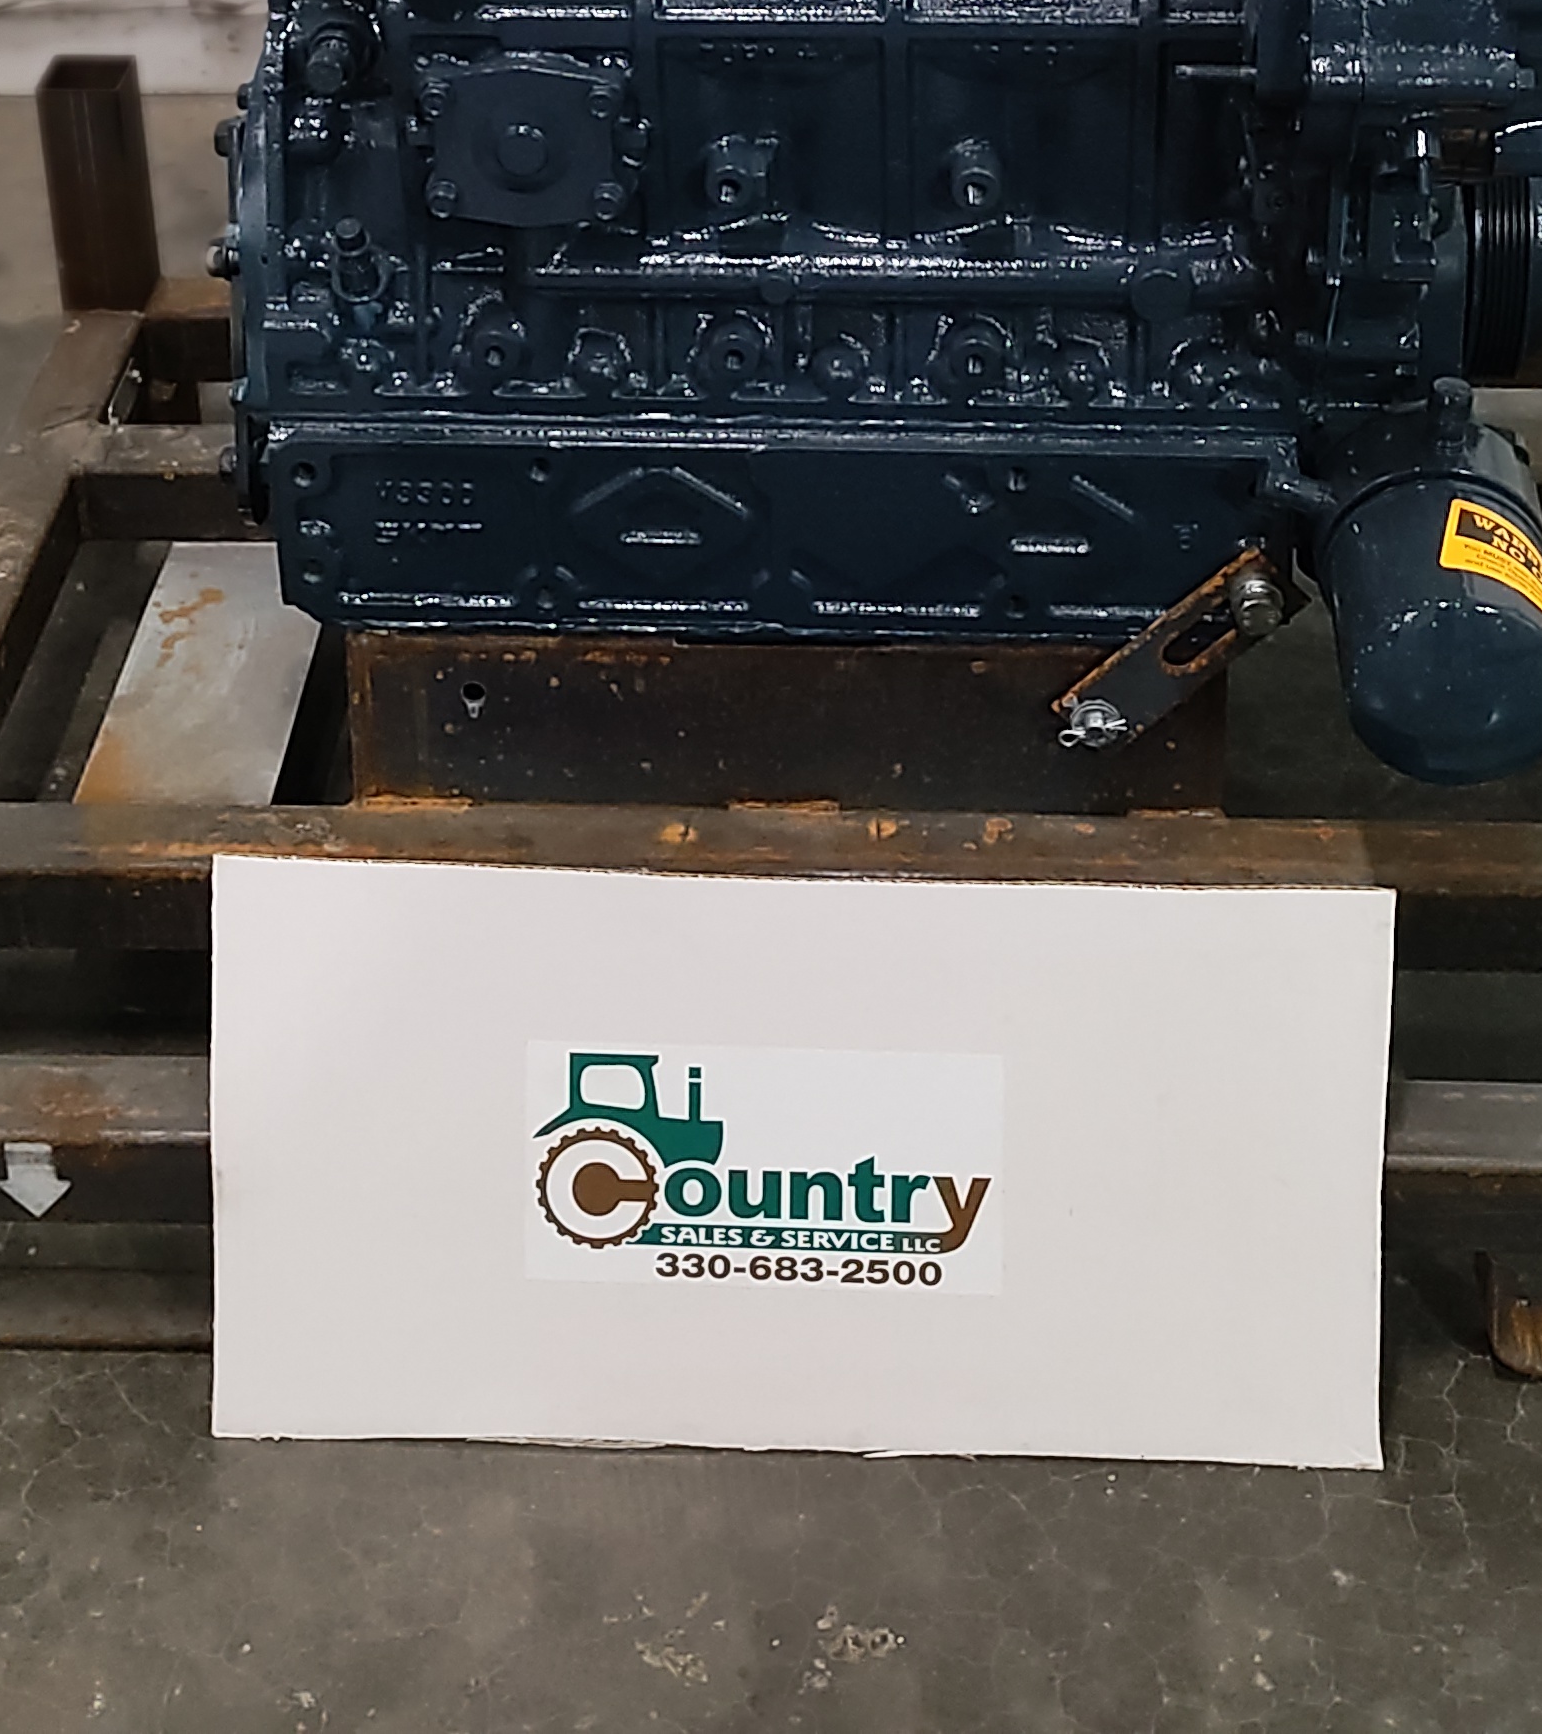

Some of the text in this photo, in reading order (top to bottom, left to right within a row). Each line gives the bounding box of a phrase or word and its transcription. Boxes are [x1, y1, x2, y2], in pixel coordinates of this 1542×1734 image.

[542, 1134, 992, 1251] Country
[660, 1225, 942, 1253] SALES & SERVICE LLC
[655, 1252, 943, 1286] 330-683-2500
